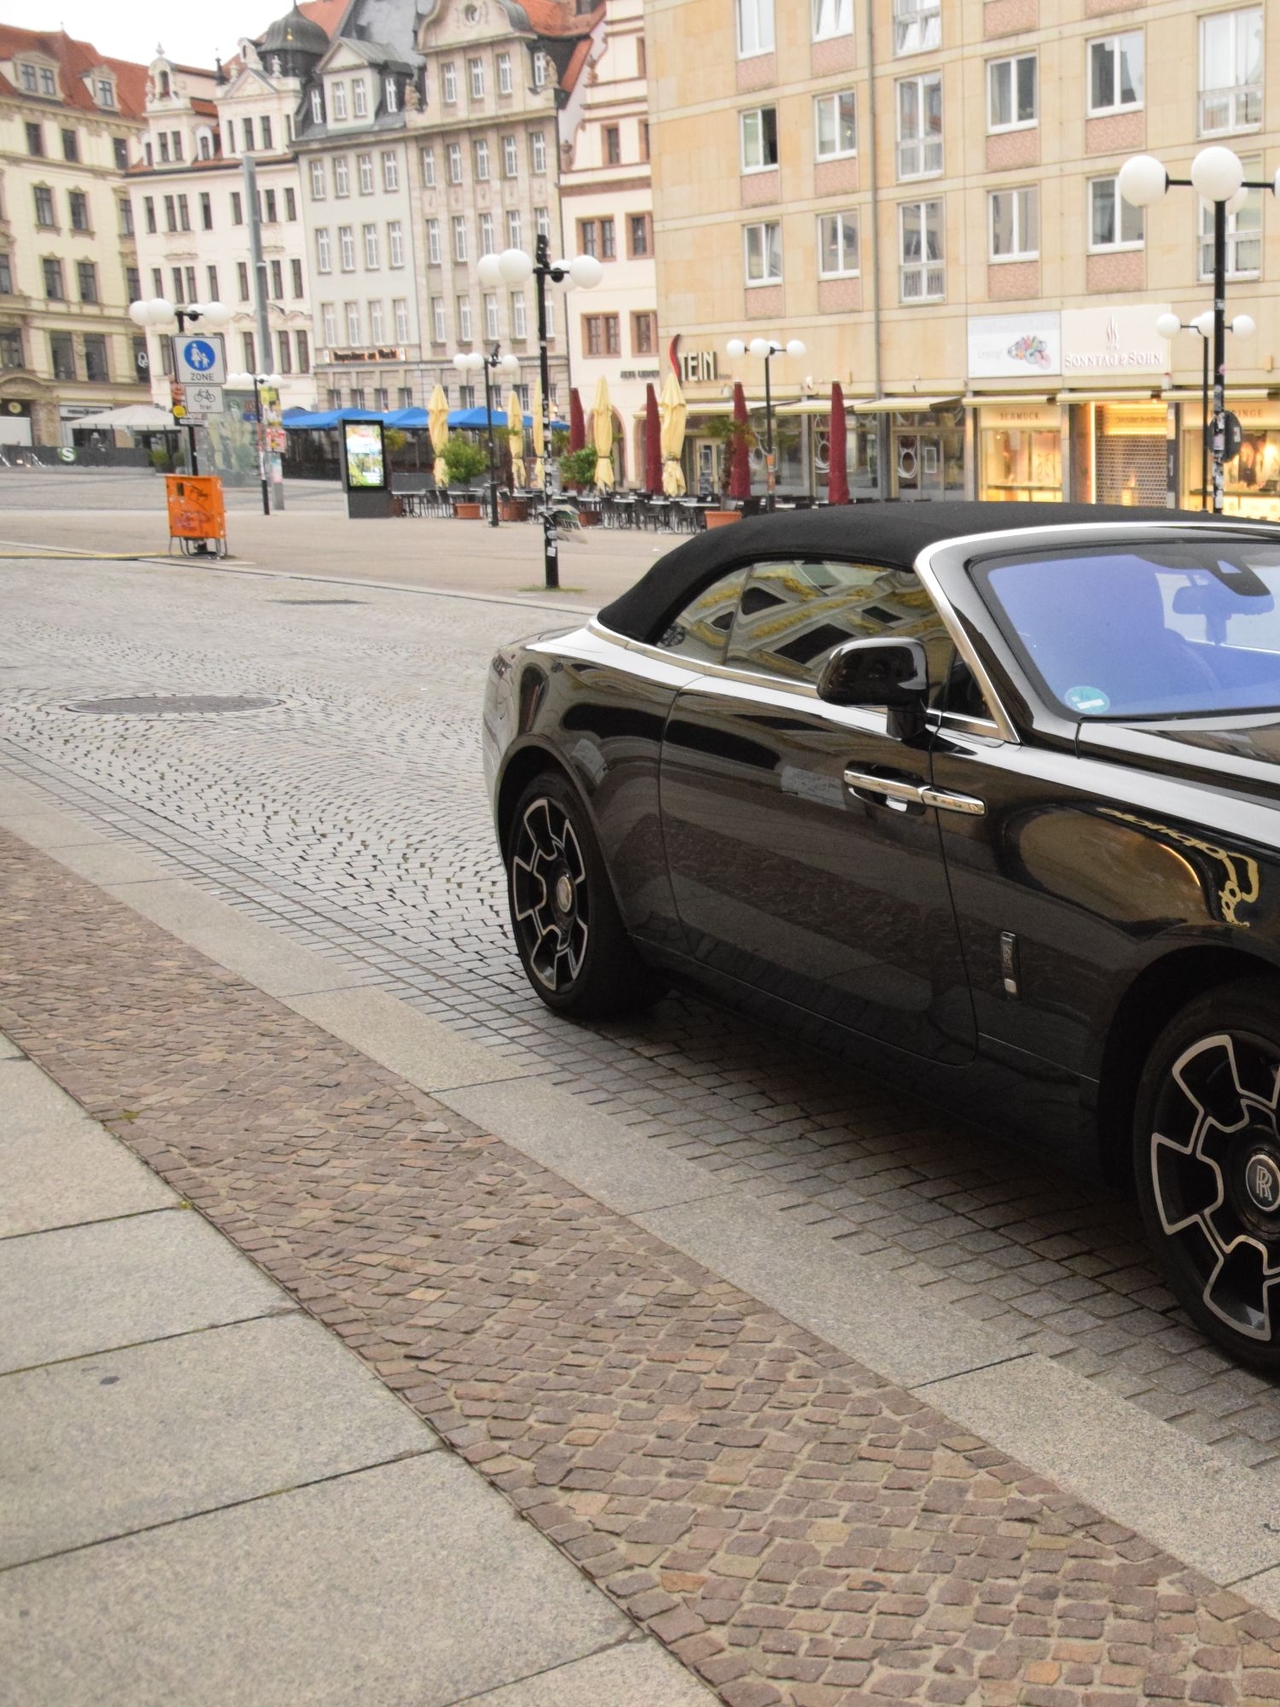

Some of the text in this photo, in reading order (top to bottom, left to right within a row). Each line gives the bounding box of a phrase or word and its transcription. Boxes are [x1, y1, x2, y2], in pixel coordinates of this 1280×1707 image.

[1065, 354, 1118, 368] SONNTAG
[1128, 351, 1162, 366] SOHN
[190, 372, 214, 381] ZONE
[1000, 411, 1039, 421] SCHMUCK
